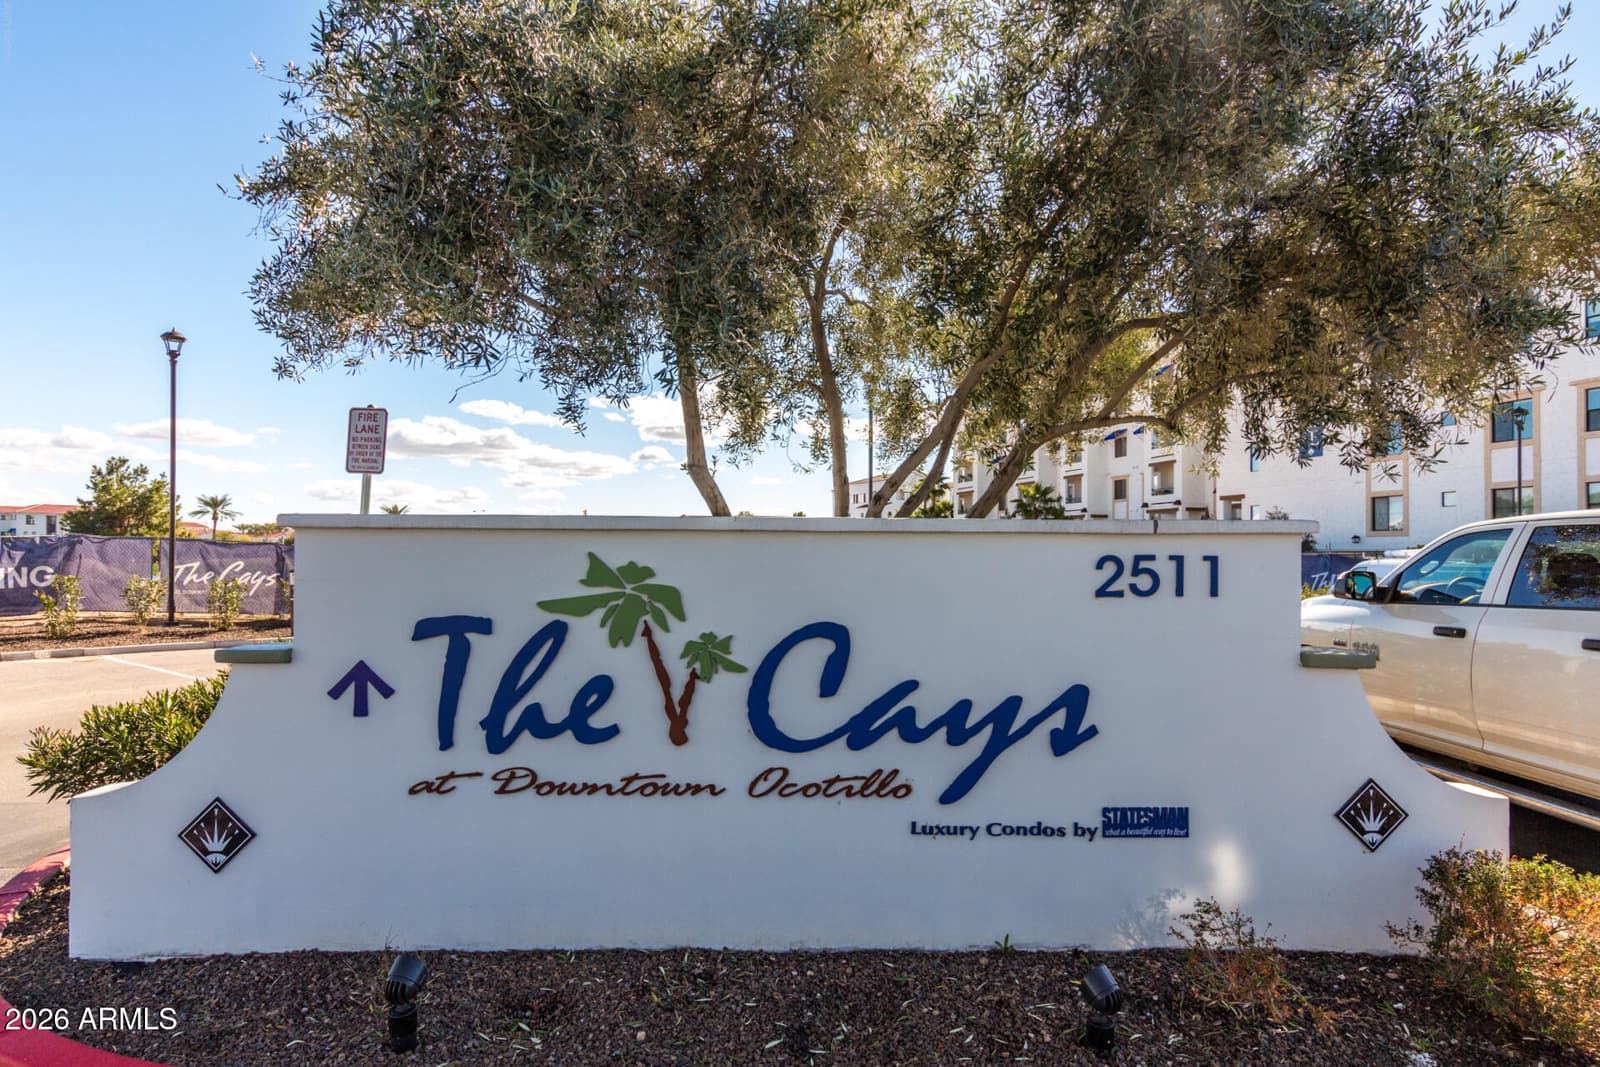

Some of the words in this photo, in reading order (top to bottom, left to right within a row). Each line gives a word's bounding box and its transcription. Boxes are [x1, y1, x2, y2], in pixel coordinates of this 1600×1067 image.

[355, 424, 380, 434] LANE
[358, 412, 379, 422] FIRE
[174, 562, 215, 585] The
[219, 561, 280, 596] Cays
[1094, 555, 1219, 598] 2511
[411, 615, 621, 755] The
[747, 621, 1100, 805] Cays
[407, 771, 484, 796] at
[491, 767, 727, 797] Downtown
[747, 767, 914, 799] Ocotillo
[1102, 807, 1189, 825] STATESMAN
[910, 821, 980, 840] Luxury
[986, 821, 1066, 837] Condos
[1073, 822, 1098, 842] by
